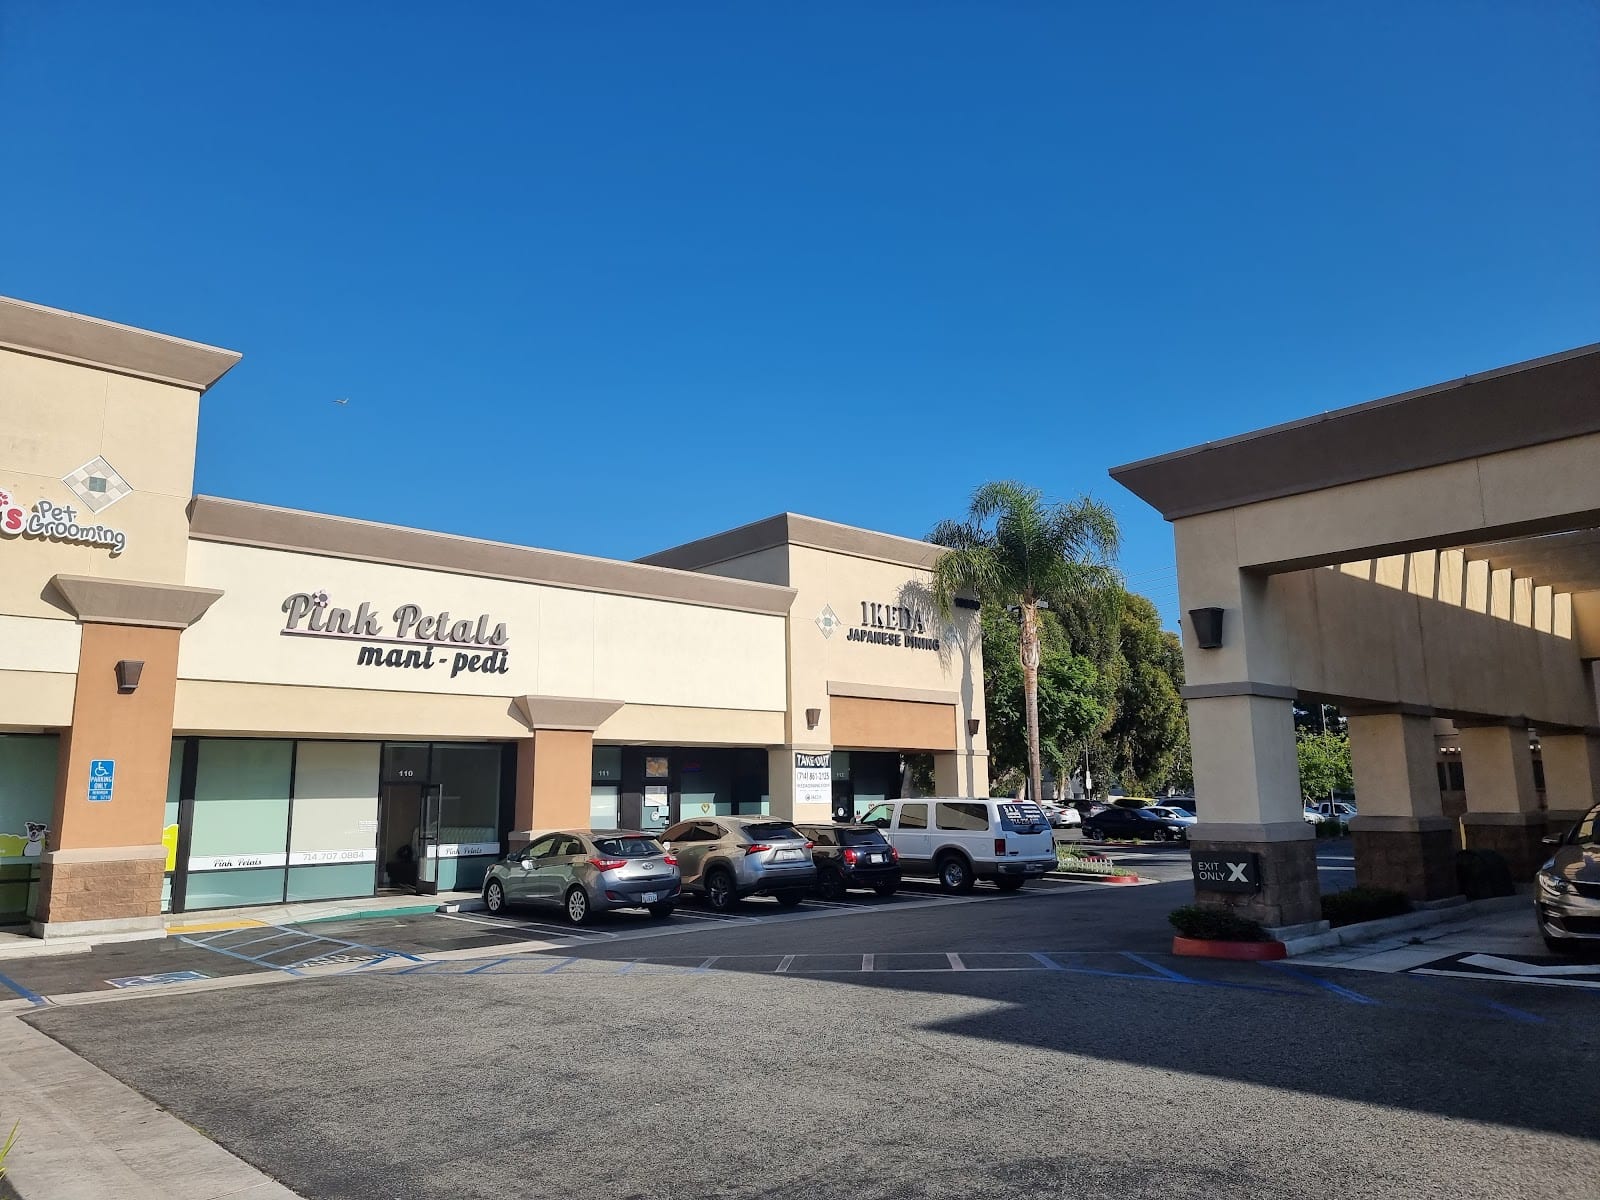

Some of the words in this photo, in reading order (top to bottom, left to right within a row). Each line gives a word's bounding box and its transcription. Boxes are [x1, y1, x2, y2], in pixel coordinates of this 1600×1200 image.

[38, 500, 77, 523] Pet
[28, 514, 125, 551] Grooming
[281, 590, 382, 635] Pink
[393, 603, 509, 646] Petals
[861, 601, 926, 633] IKEDA
[847, 628, 901, 646] JAPANESE
[904, 636, 940, 651] DINING
[1198, 862, 1219, 871] EXIT
[1200, 872, 1226, 881] ONLY
